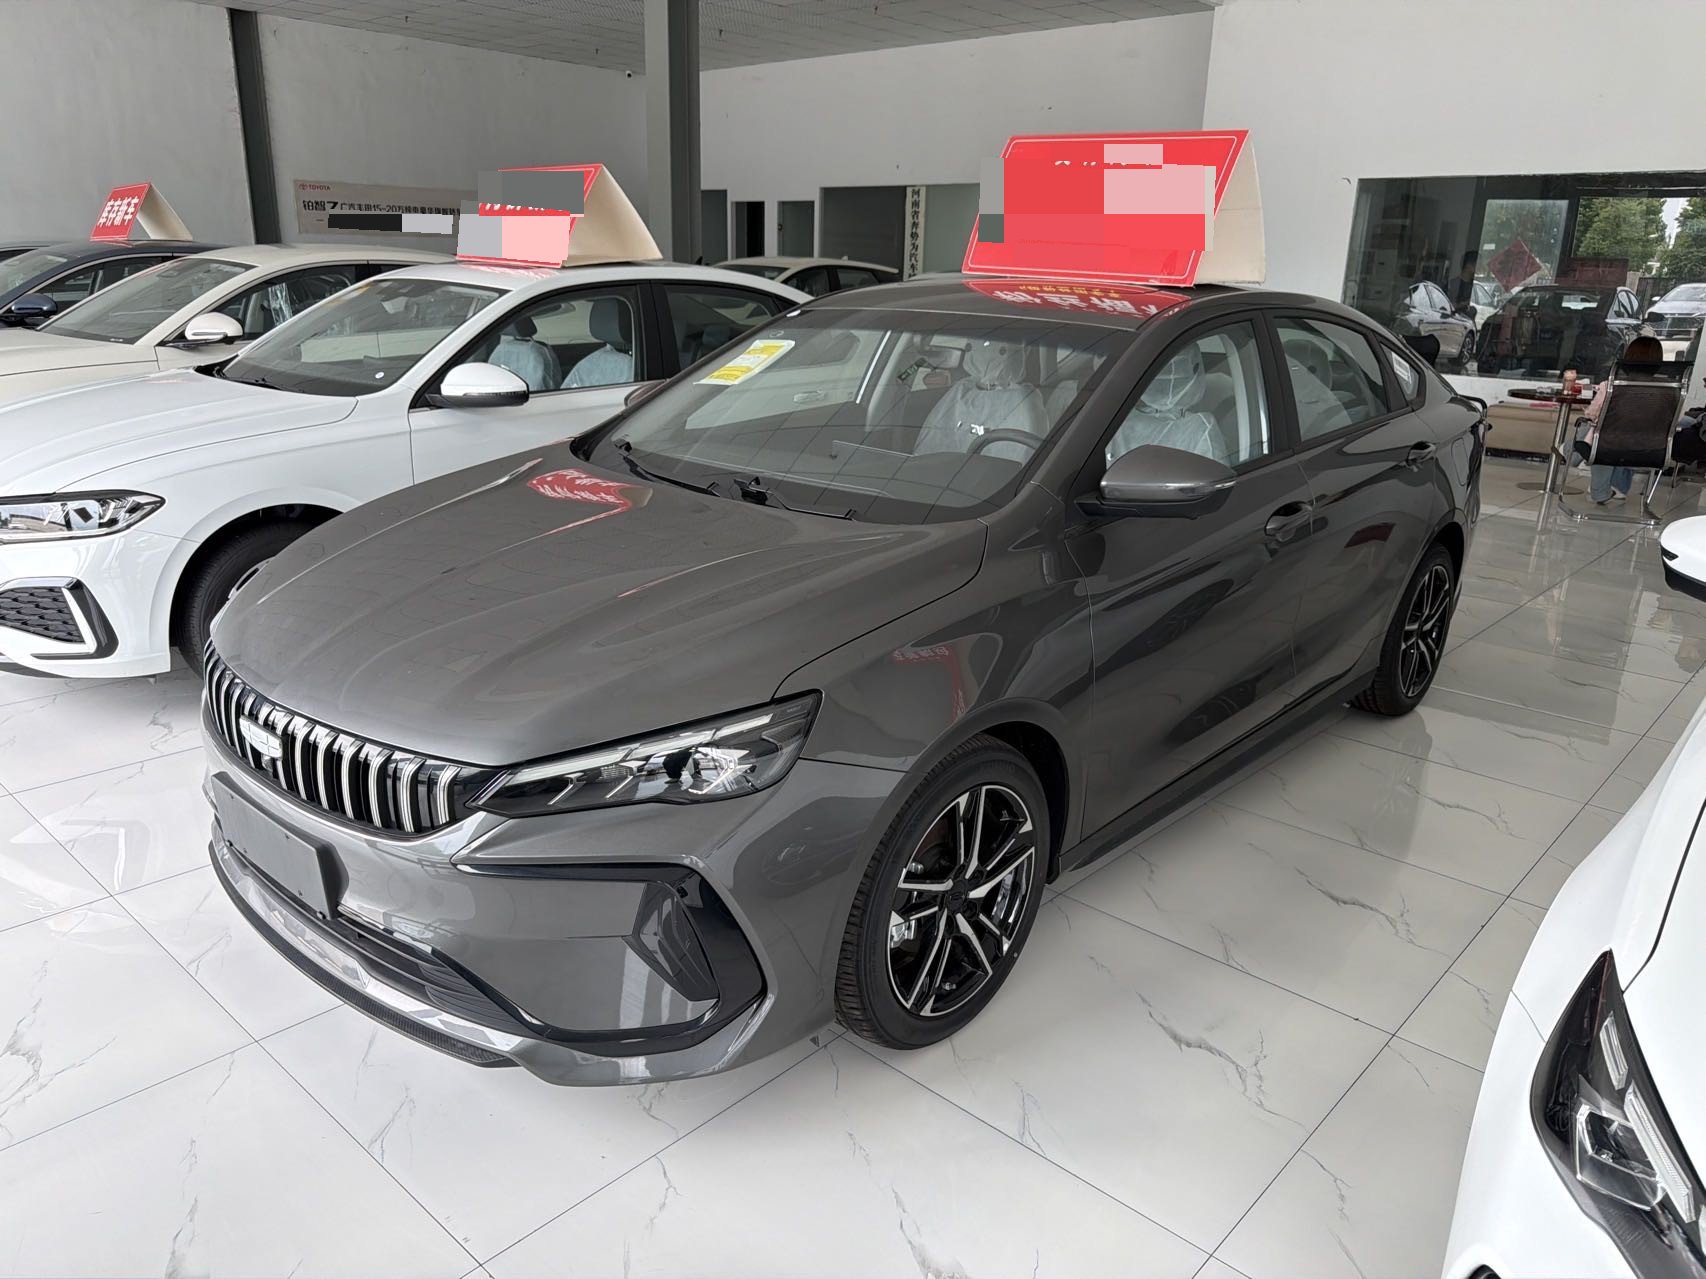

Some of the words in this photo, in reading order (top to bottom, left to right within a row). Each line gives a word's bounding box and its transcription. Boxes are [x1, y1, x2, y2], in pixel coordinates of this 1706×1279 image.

[308, 183, 331, 191] TOYOTA
[97, 195, 139, 227] 库存新车
[302, 200, 338, 211] 铂智7
